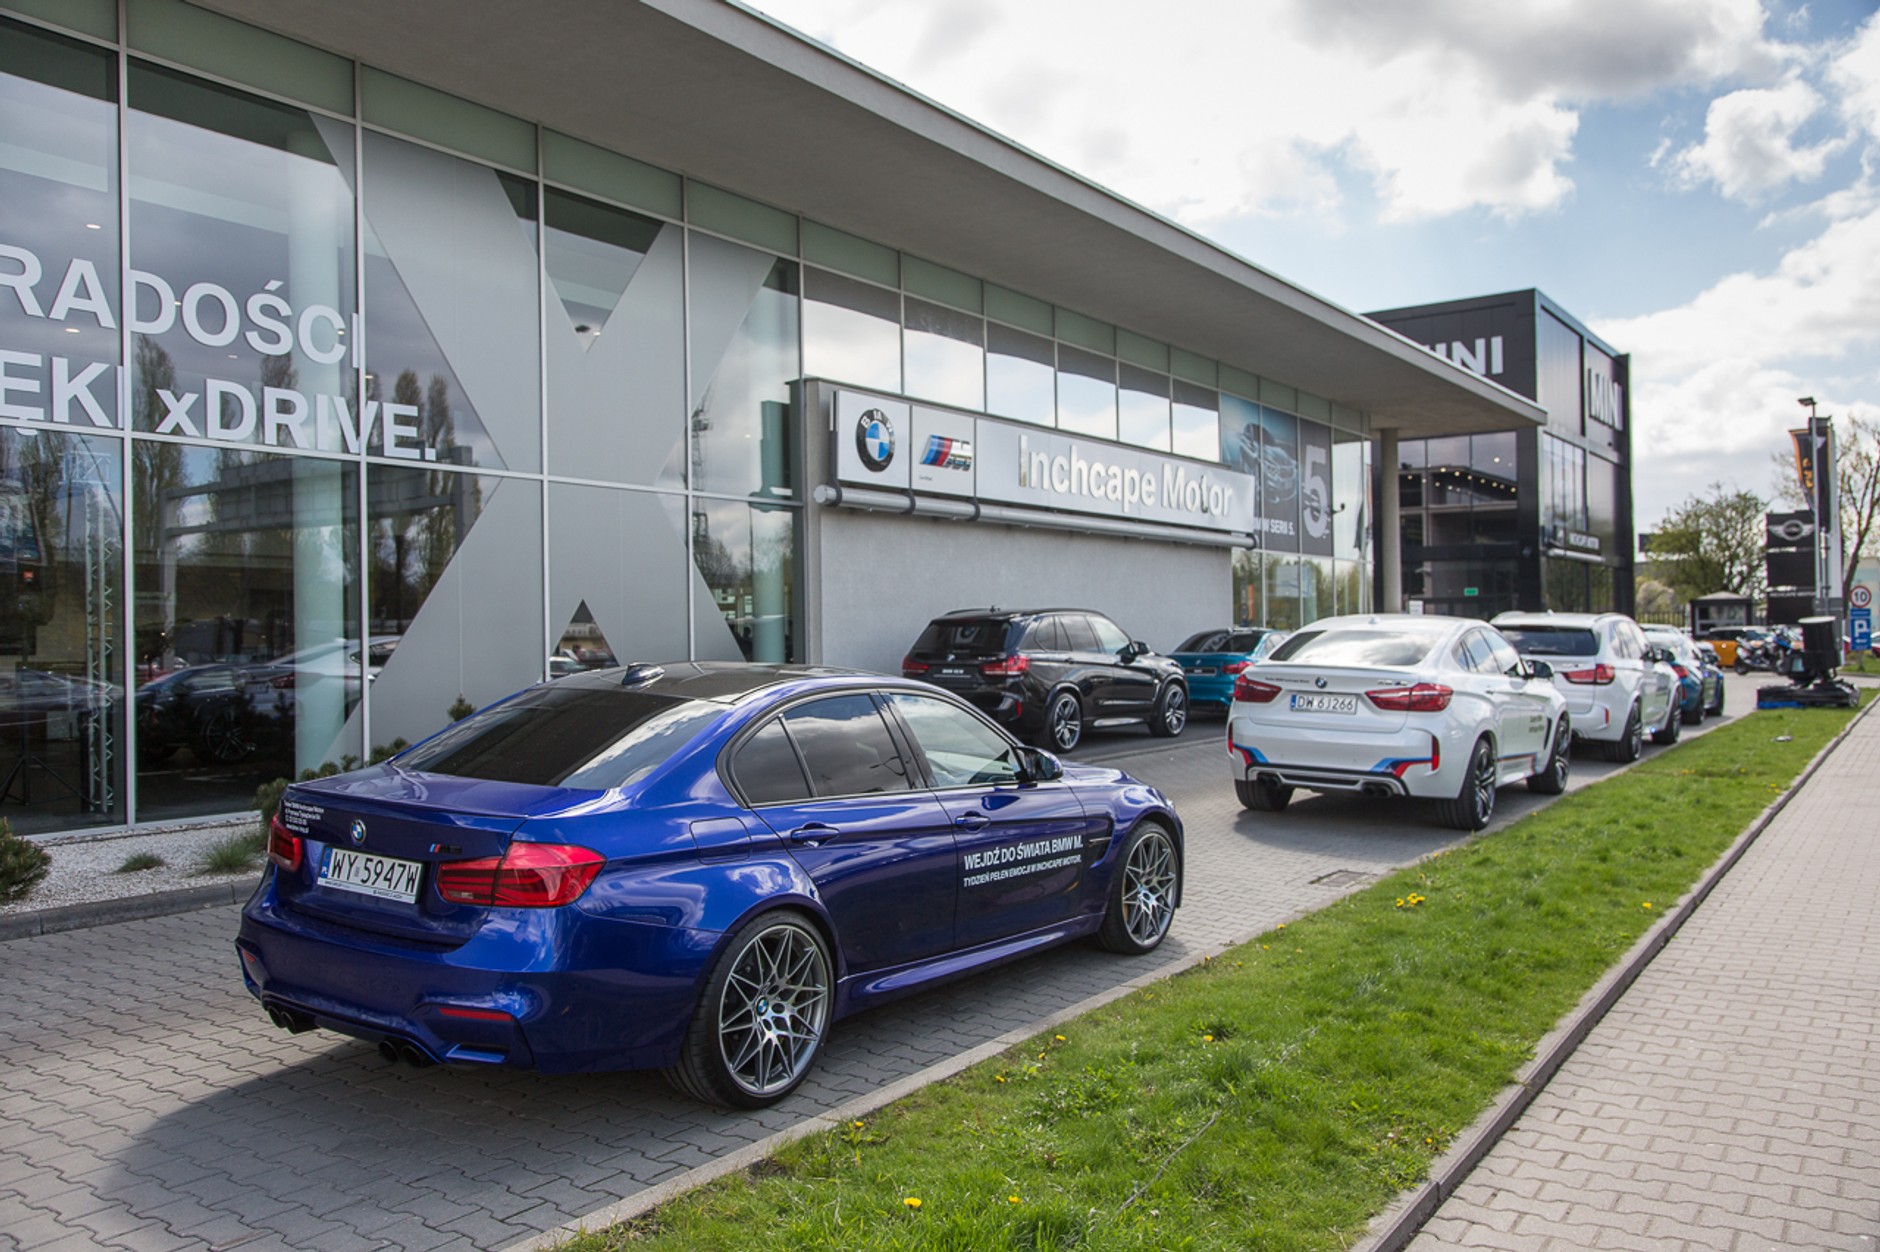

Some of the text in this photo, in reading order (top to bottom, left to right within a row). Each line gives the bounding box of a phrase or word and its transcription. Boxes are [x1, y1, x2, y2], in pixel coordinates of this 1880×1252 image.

[1588, 368, 1623, 432] MINI
[1019, 434, 1233, 516] Inchcape Motor
[1854, 591, 1868, 602] 10
[1855, 620, 1868, 638] P
[1297, 695, 1354, 711] DW 6J266
[964, 846, 1000, 870] WEJDŹ
[1001, 846, 1016, 863] DO
[1016, 841, 1051, 860] ŚWIATA
[1051, 836, 1073, 854] BMW
[330, 851, 420, 894] WY 5947W
